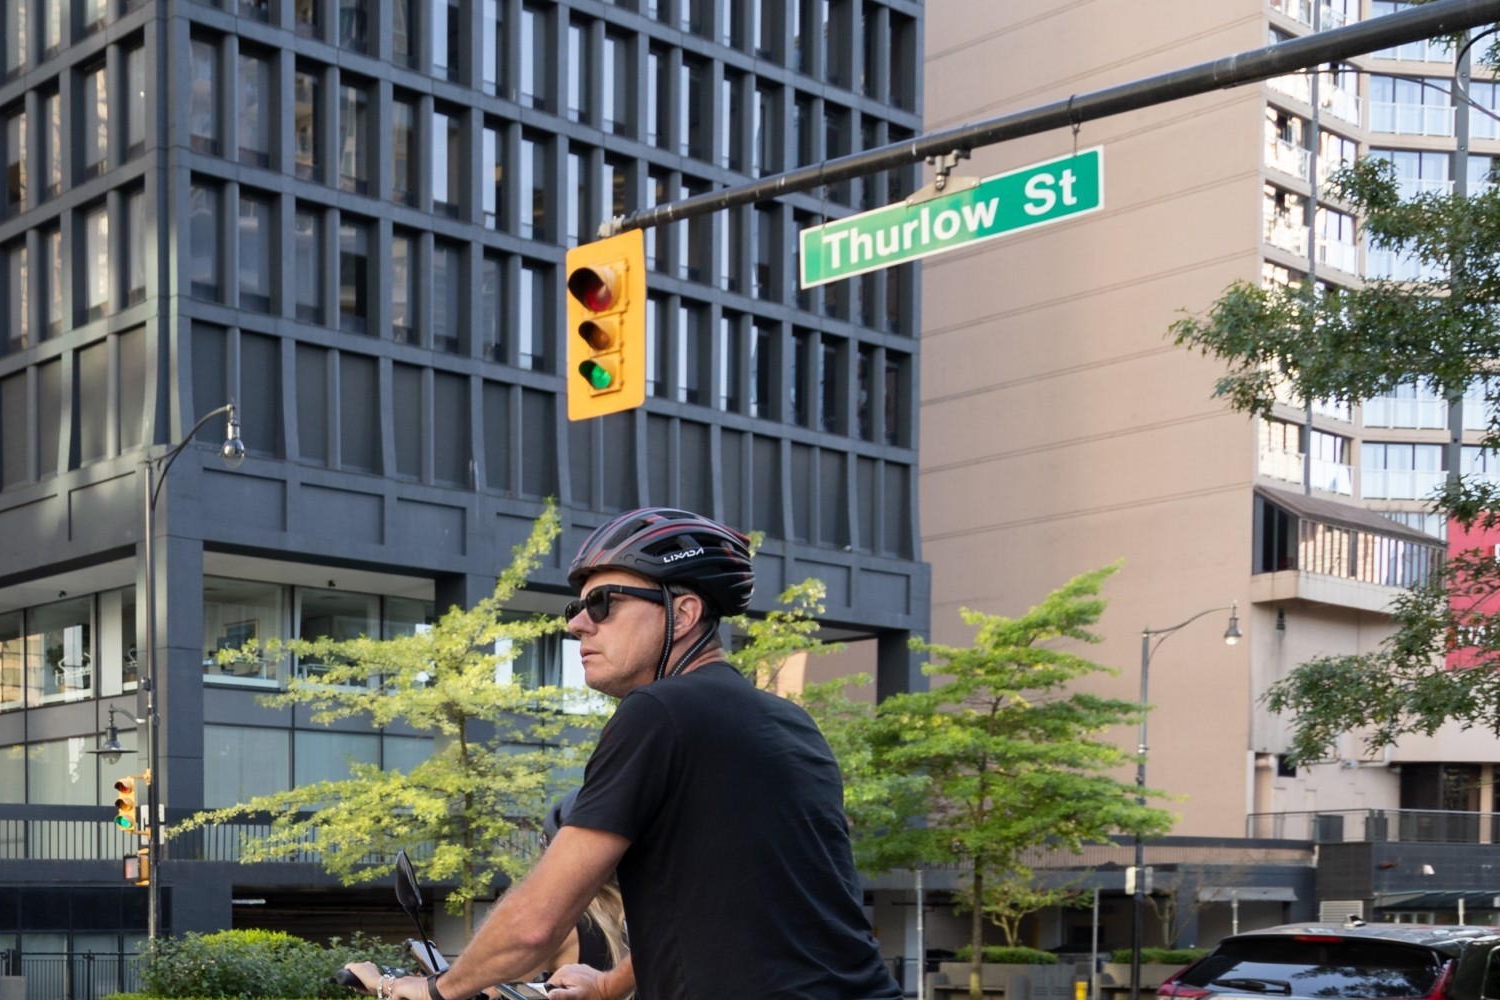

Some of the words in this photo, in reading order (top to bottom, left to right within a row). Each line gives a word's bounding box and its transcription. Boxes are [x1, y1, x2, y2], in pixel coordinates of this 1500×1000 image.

[822, 197, 1000, 269] Thurlow
[1023, 168, 1078, 216] St
[663, 547, 705, 563] LIXADA
